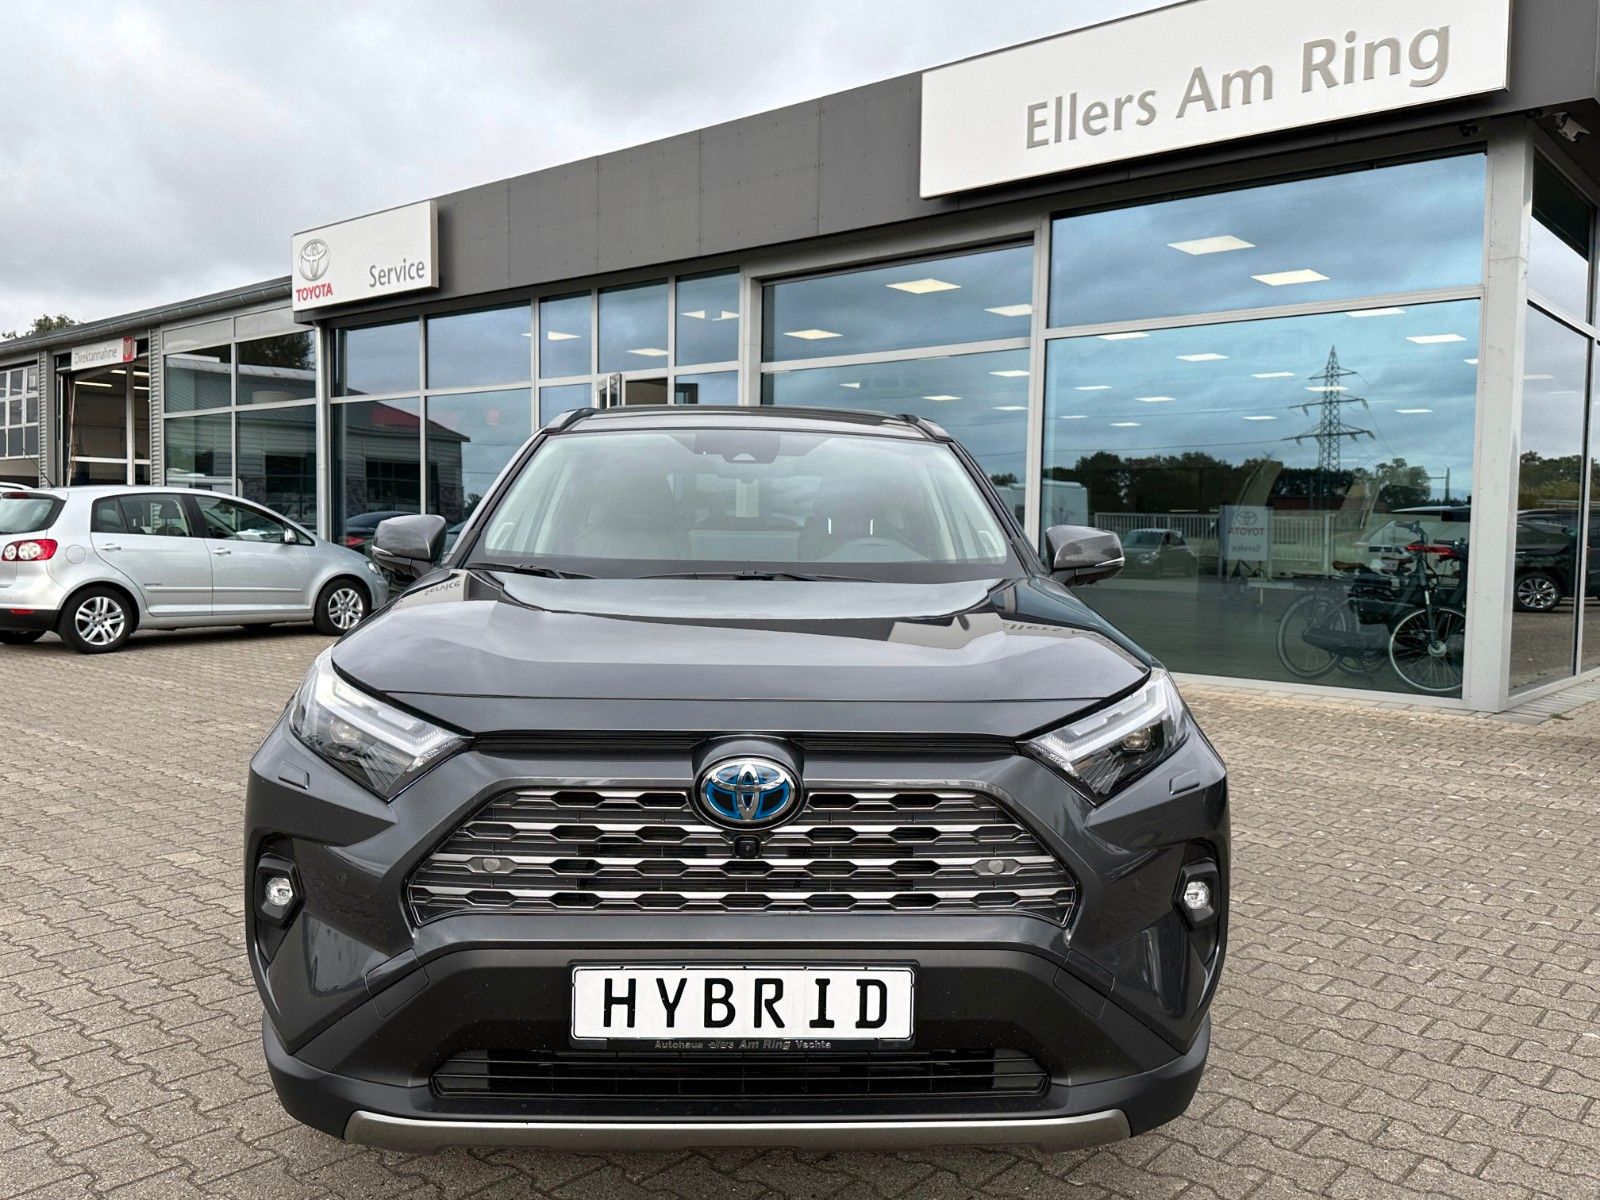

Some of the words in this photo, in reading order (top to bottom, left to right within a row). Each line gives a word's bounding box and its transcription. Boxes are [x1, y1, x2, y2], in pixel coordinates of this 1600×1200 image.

[1026, 90, 1156, 149] Ellers
[1176, 64, 1274, 119] Am
[1301, 25, 1451, 94] Ring
[369, 258, 425, 288] Service
[296, 283, 333, 302] TOYOTA
[74, 346, 118, 364] Direktannahme
[603, 977, 888, 1029] HYBRID
[654, 1040, 704, 1049] Autohaus
[738, 1039, 759, 1049] Am
[763, 1039, 791, 1051] Ring
[794, 1040, 832, 1049] Vechta
